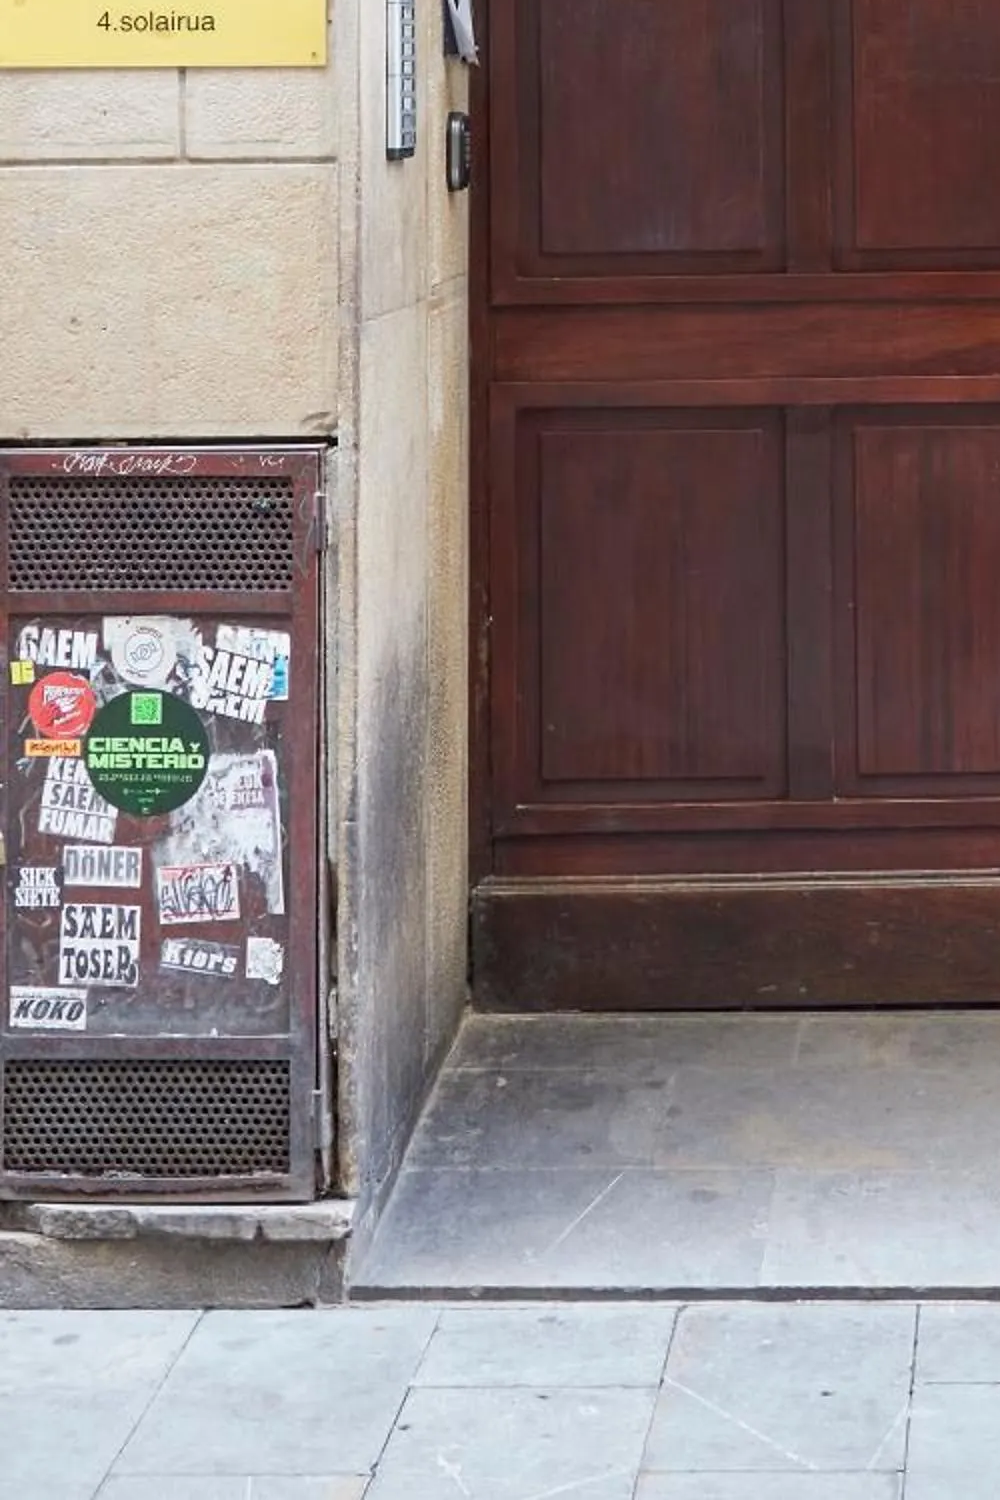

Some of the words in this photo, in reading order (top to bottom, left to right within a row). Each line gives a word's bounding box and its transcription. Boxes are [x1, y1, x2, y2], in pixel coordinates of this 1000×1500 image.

[96, 10, 216, 33] 4.solairua
[88, 737, 185, 753] CIENCIA
[88, 753, 205, 769] MISTERIO
[63, 905, 137, 940] SAEM
